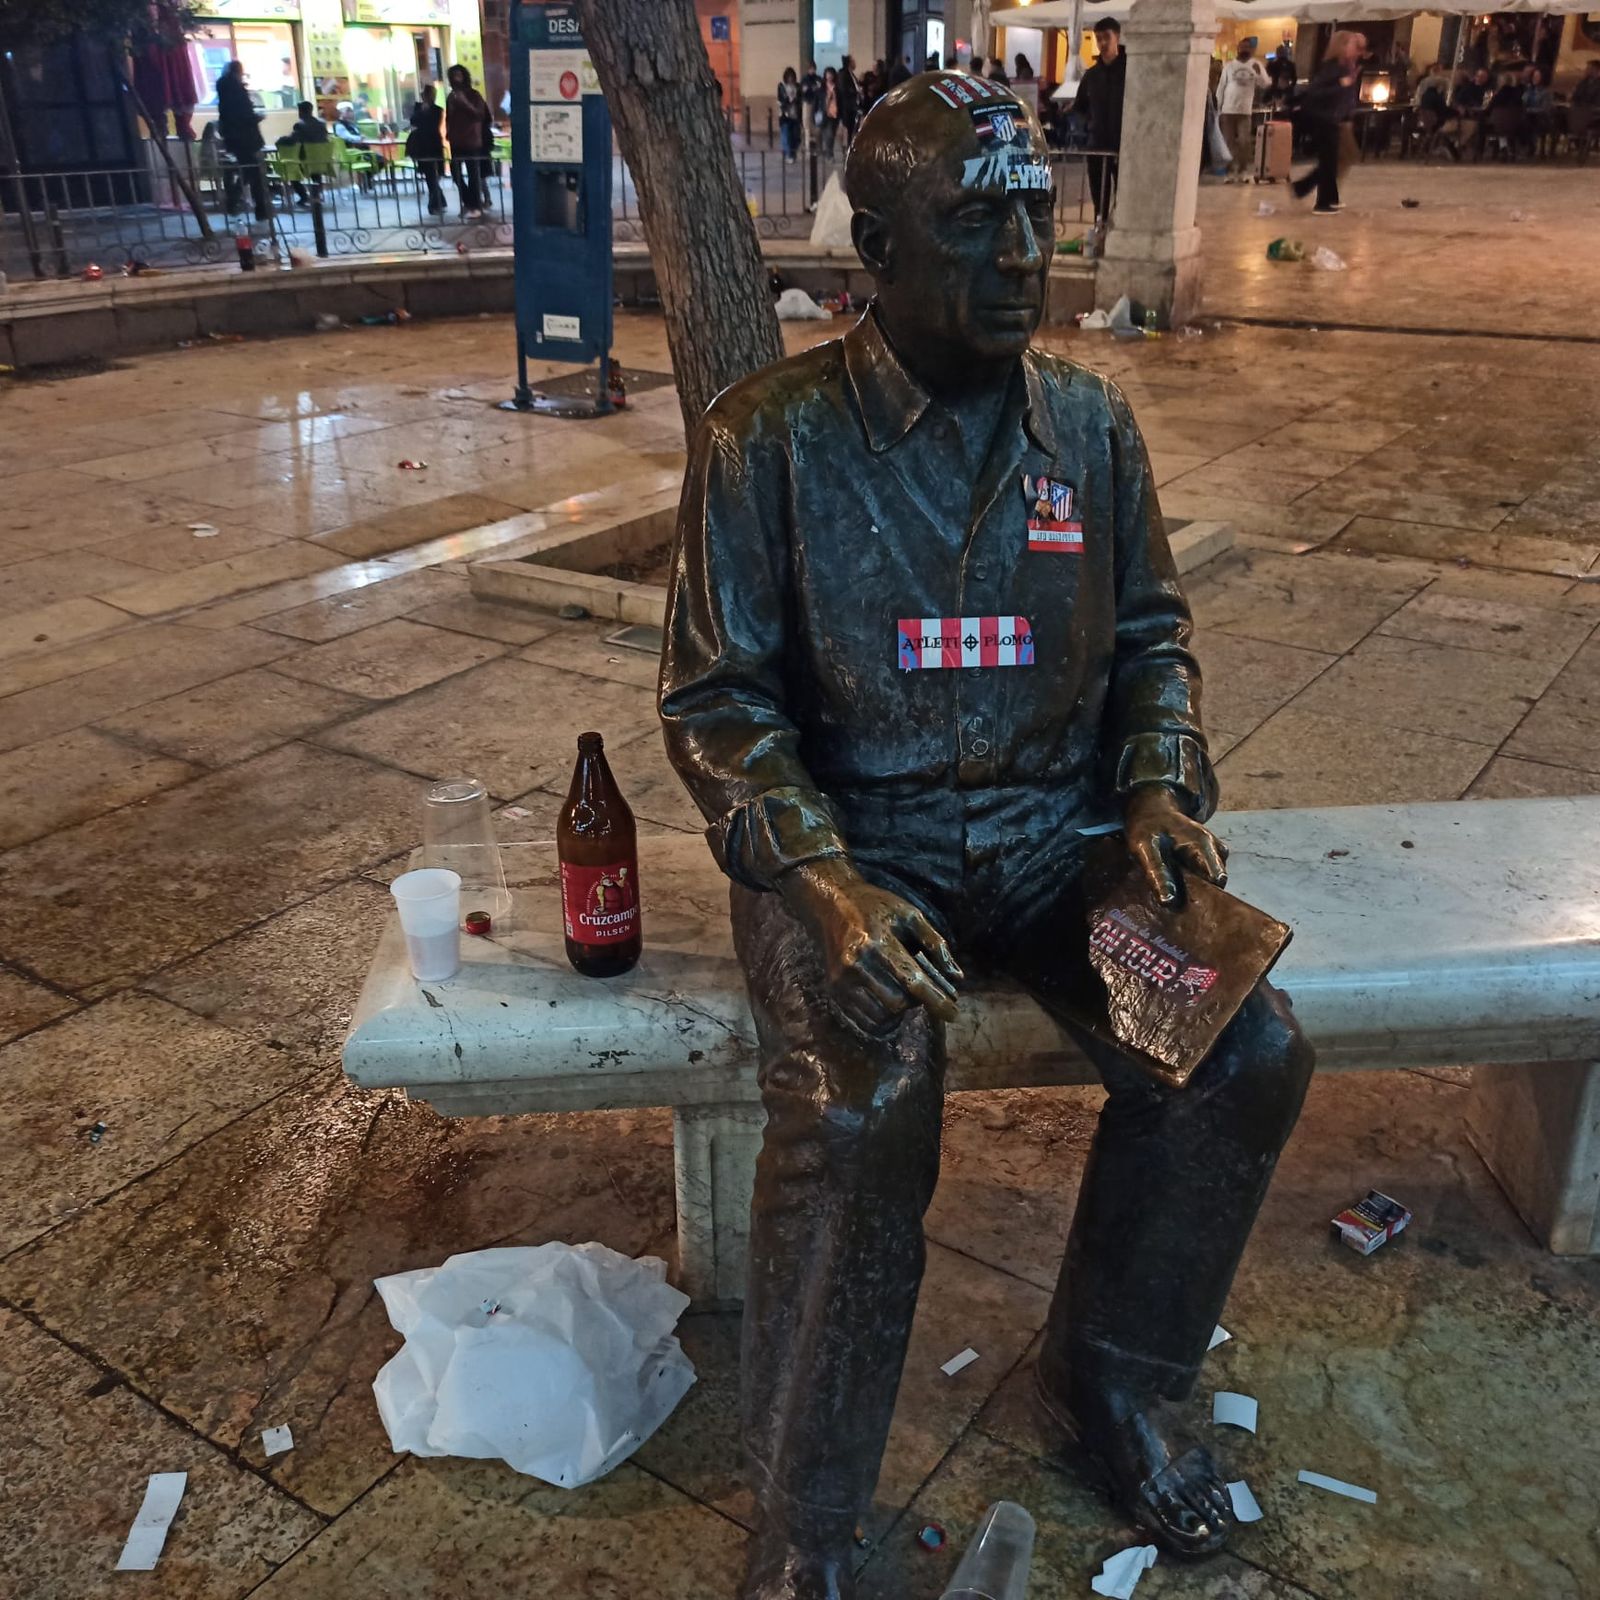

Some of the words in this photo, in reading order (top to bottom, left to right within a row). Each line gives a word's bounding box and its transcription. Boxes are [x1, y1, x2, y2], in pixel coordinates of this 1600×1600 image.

[902, 635, 961, 651] ATLETI
[983, 634, 1033, 647] PLOMO
[596, 925, 630, 937] PILSEN
[1088, 920, 1126, 953] ON
[1119, 938, 1177, 987] TOUR
